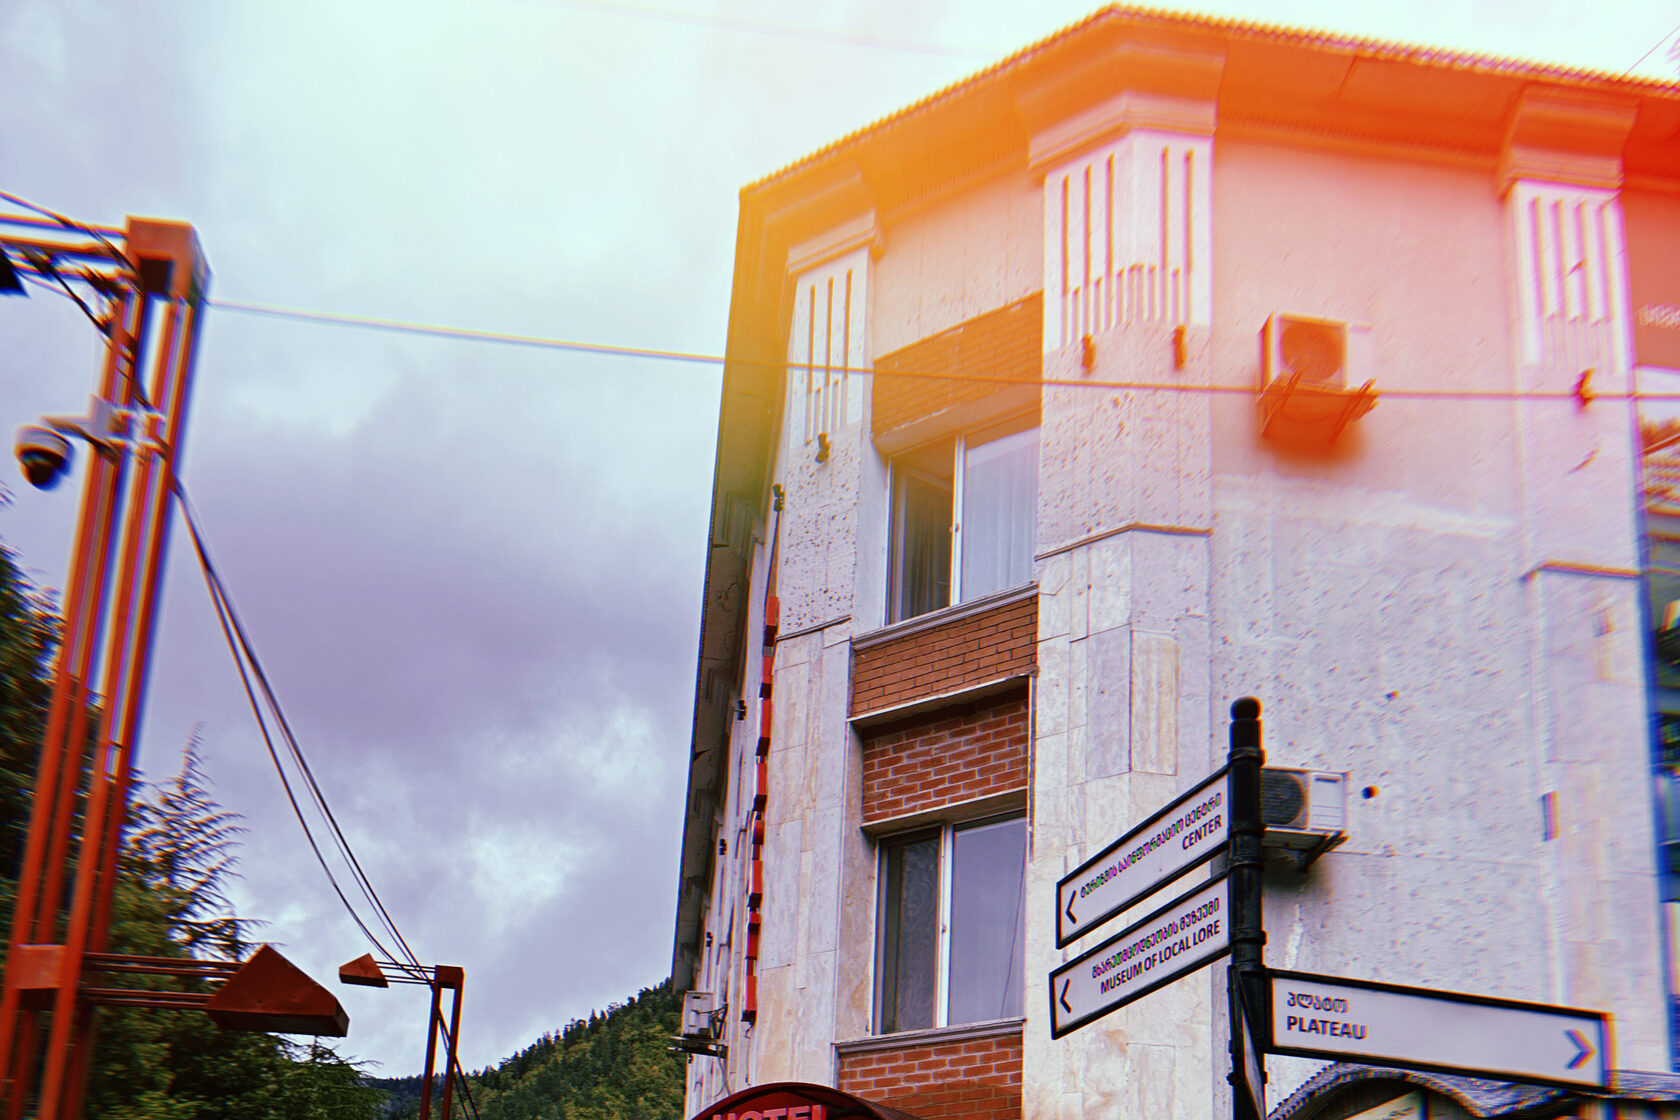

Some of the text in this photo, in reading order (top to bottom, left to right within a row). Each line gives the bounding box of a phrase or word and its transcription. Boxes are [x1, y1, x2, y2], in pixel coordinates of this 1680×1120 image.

[1118, 818, 1184, 873] საინფორმაციო
[1184, 792, 1222, 828] ცენტრი
[1182, 814, 1223, 850] CENTER
[1092, 897, 1220, 979] მხარეთმცოდნეობის მუზეუმი
[1101, 919, 1221, 994] MUSEUM OF LOCAL LORE
[1287, 991, 1351, 1013] პლატო
[1287, 1015, 1369, 1040] PLATEAU
